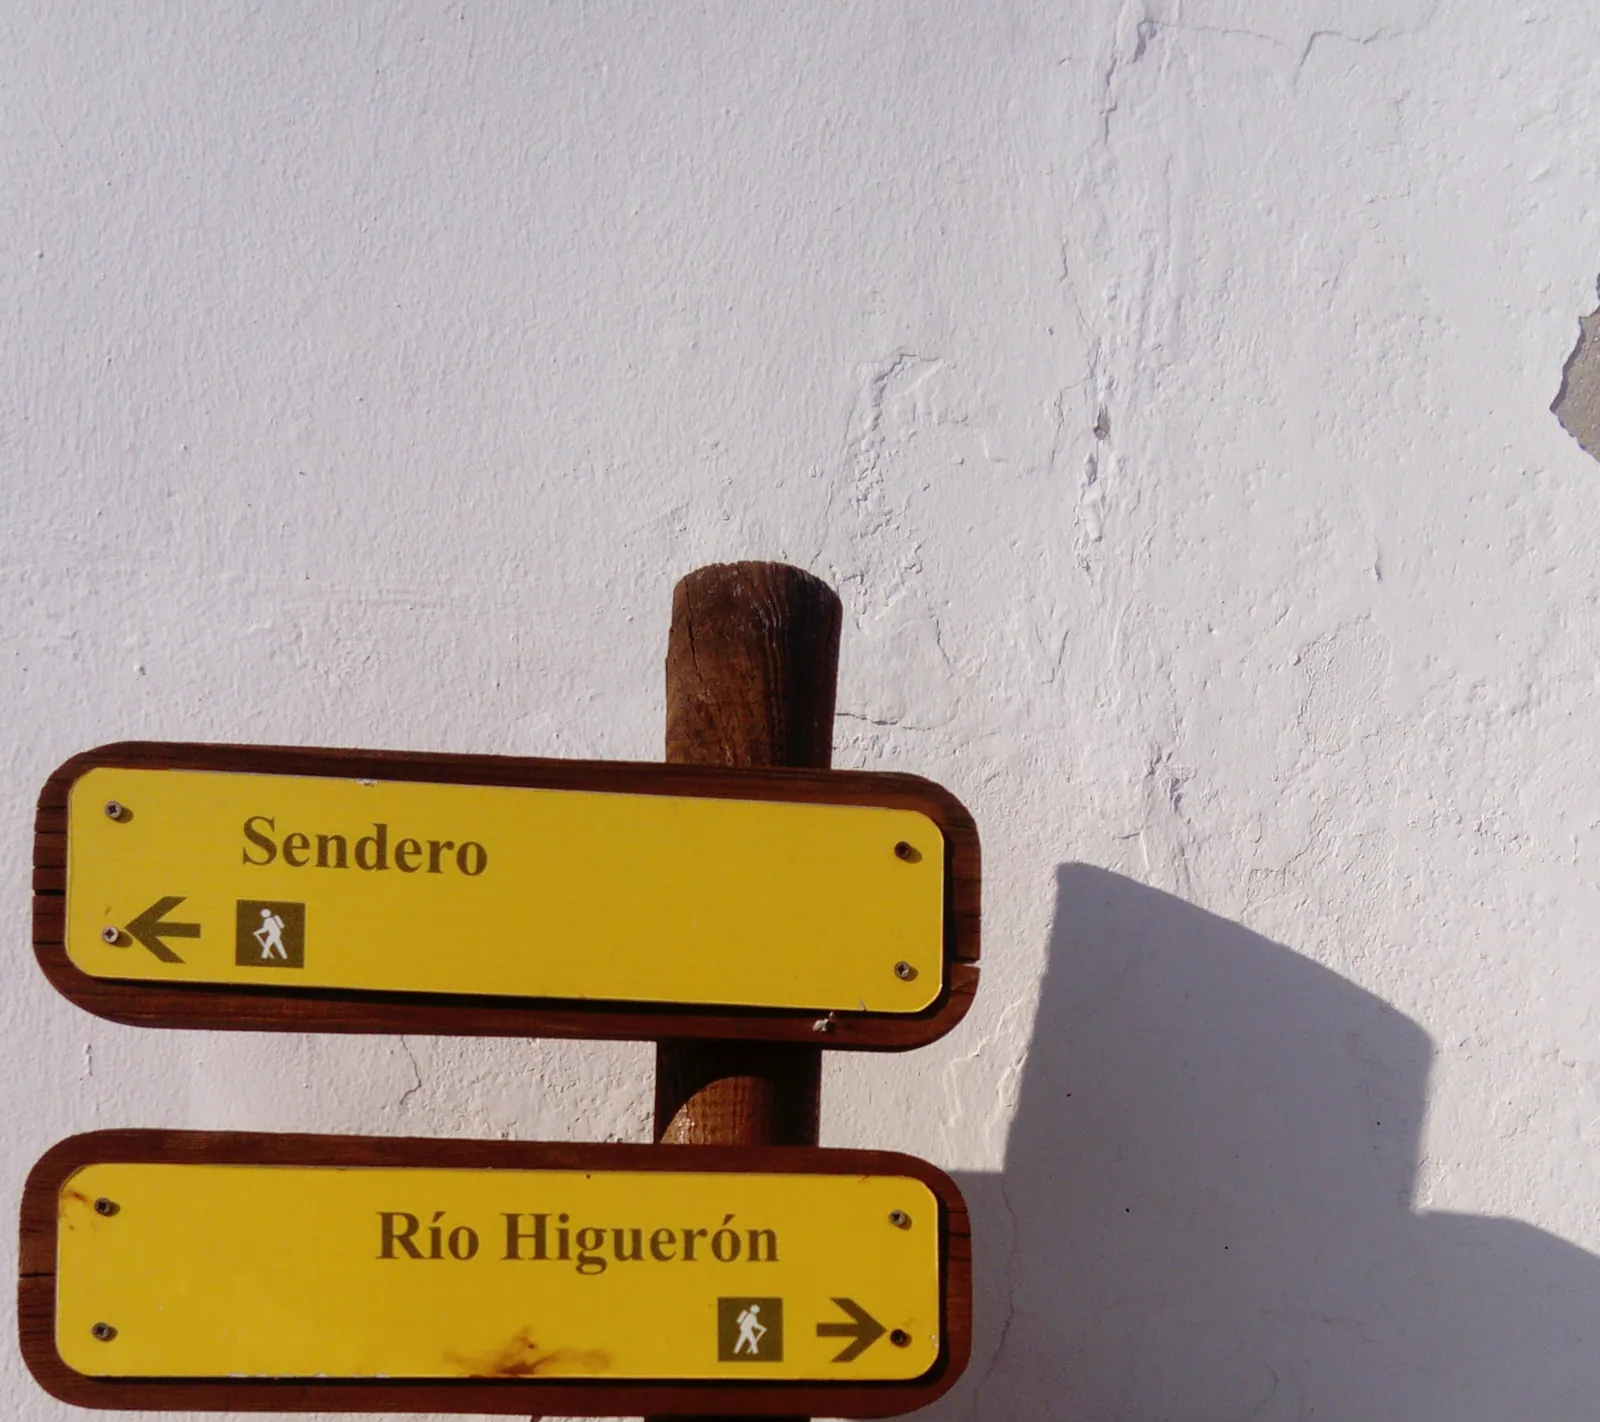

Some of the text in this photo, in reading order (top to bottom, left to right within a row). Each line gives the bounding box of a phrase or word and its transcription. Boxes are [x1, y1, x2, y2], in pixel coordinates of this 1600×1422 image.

[242, 815, 489, 877] Sendero
[376, 1211, 781, 1275] Río Higuerón
